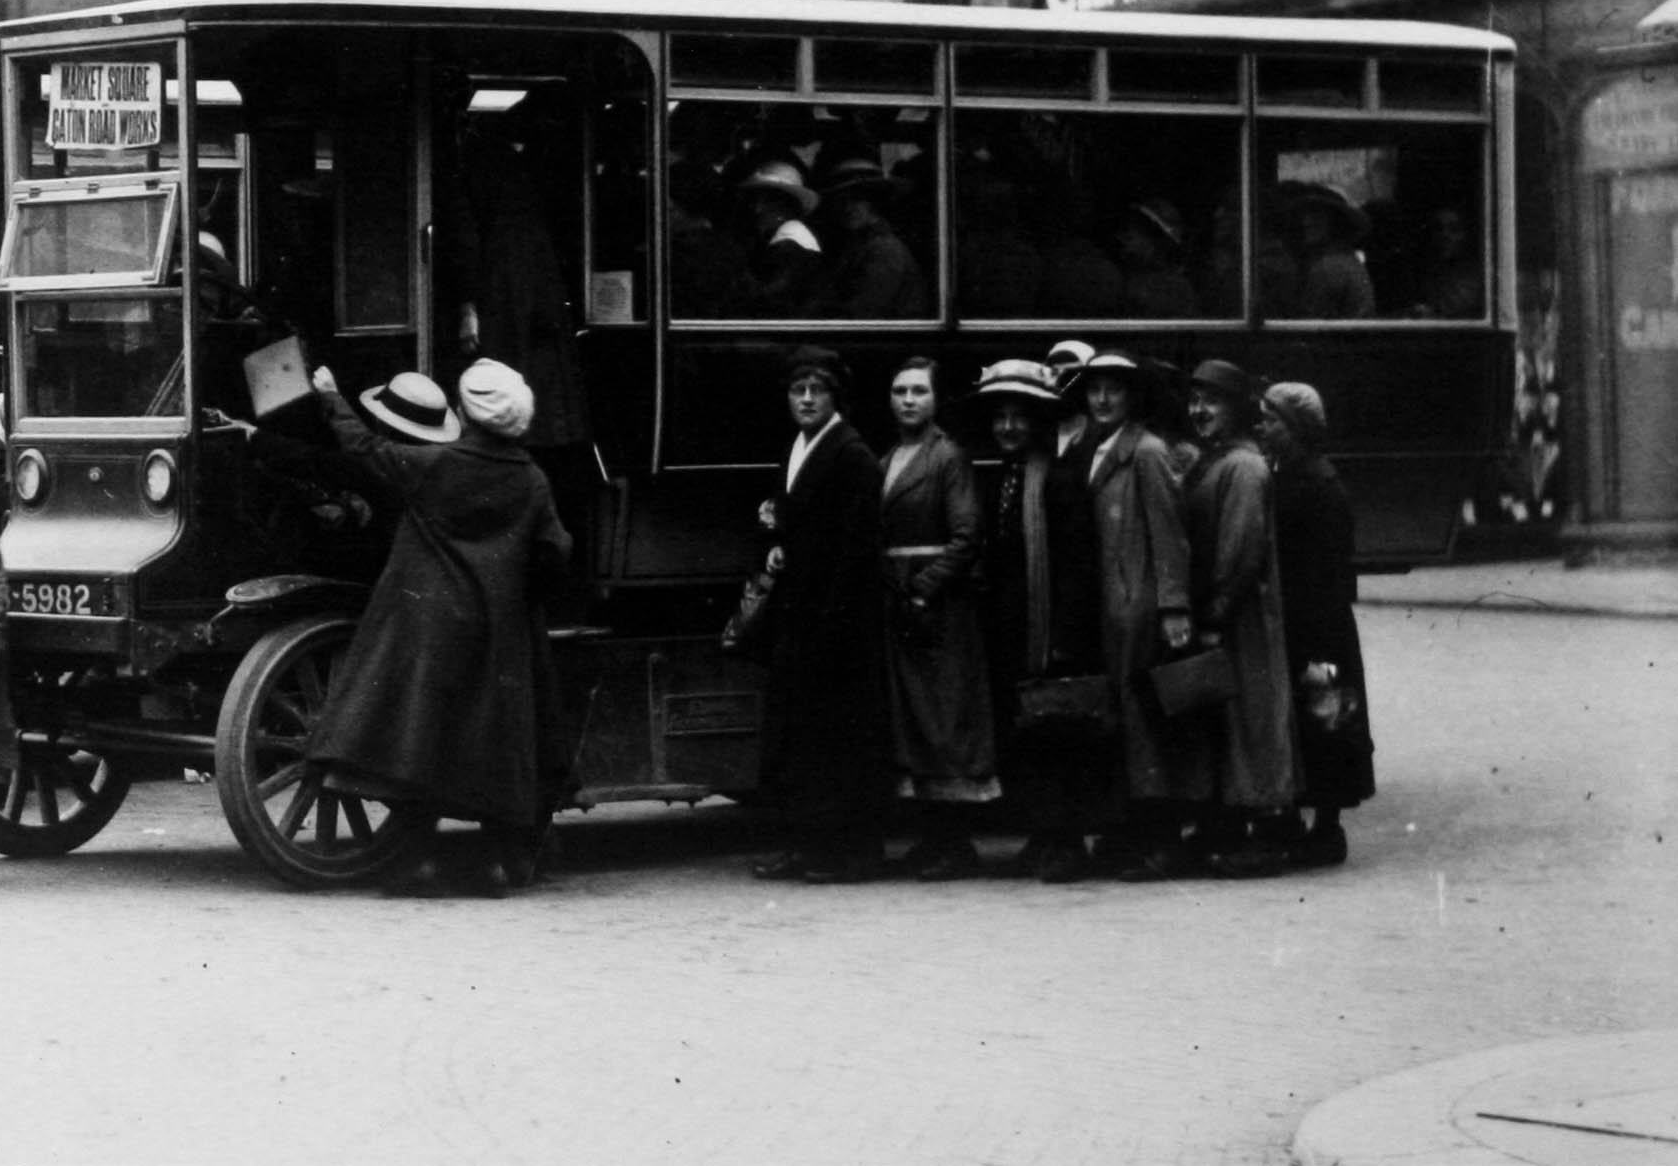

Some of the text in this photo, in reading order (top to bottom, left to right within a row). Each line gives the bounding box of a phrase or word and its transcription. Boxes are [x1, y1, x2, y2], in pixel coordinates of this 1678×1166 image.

[60, 65, 150, 101] MARKET SQUARE
[89, 109, 116, 145] ROAD
[119, 110, 159, 145] WORKS
